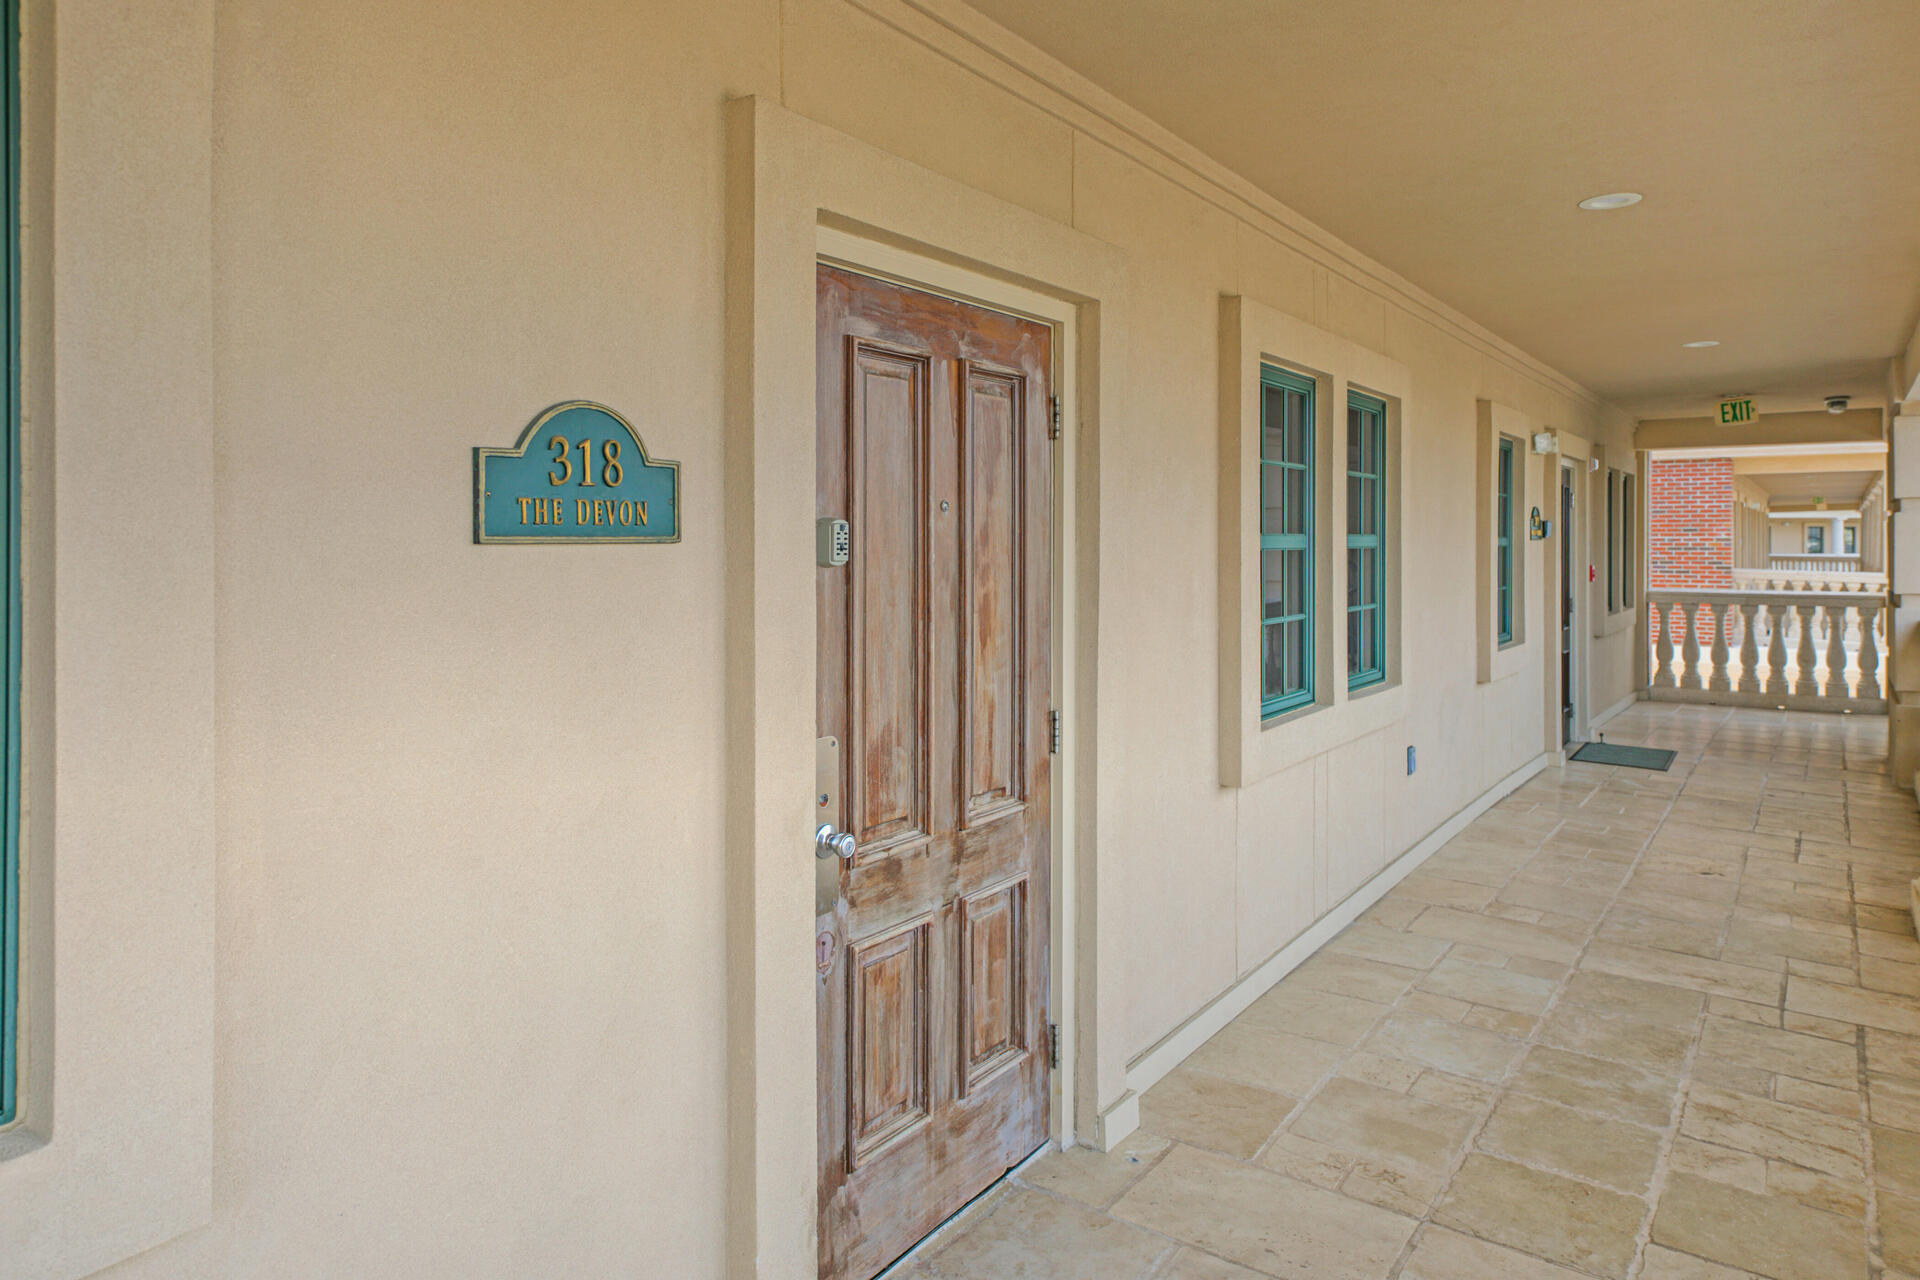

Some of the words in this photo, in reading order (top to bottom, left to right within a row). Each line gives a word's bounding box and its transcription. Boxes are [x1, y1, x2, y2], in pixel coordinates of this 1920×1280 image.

[1720, 400, 1751, 423] EXIT
[548, 435, 624, 488] 318
[517, 497, 563, 526] THE
[575, 498, 648, 527] DEVON
